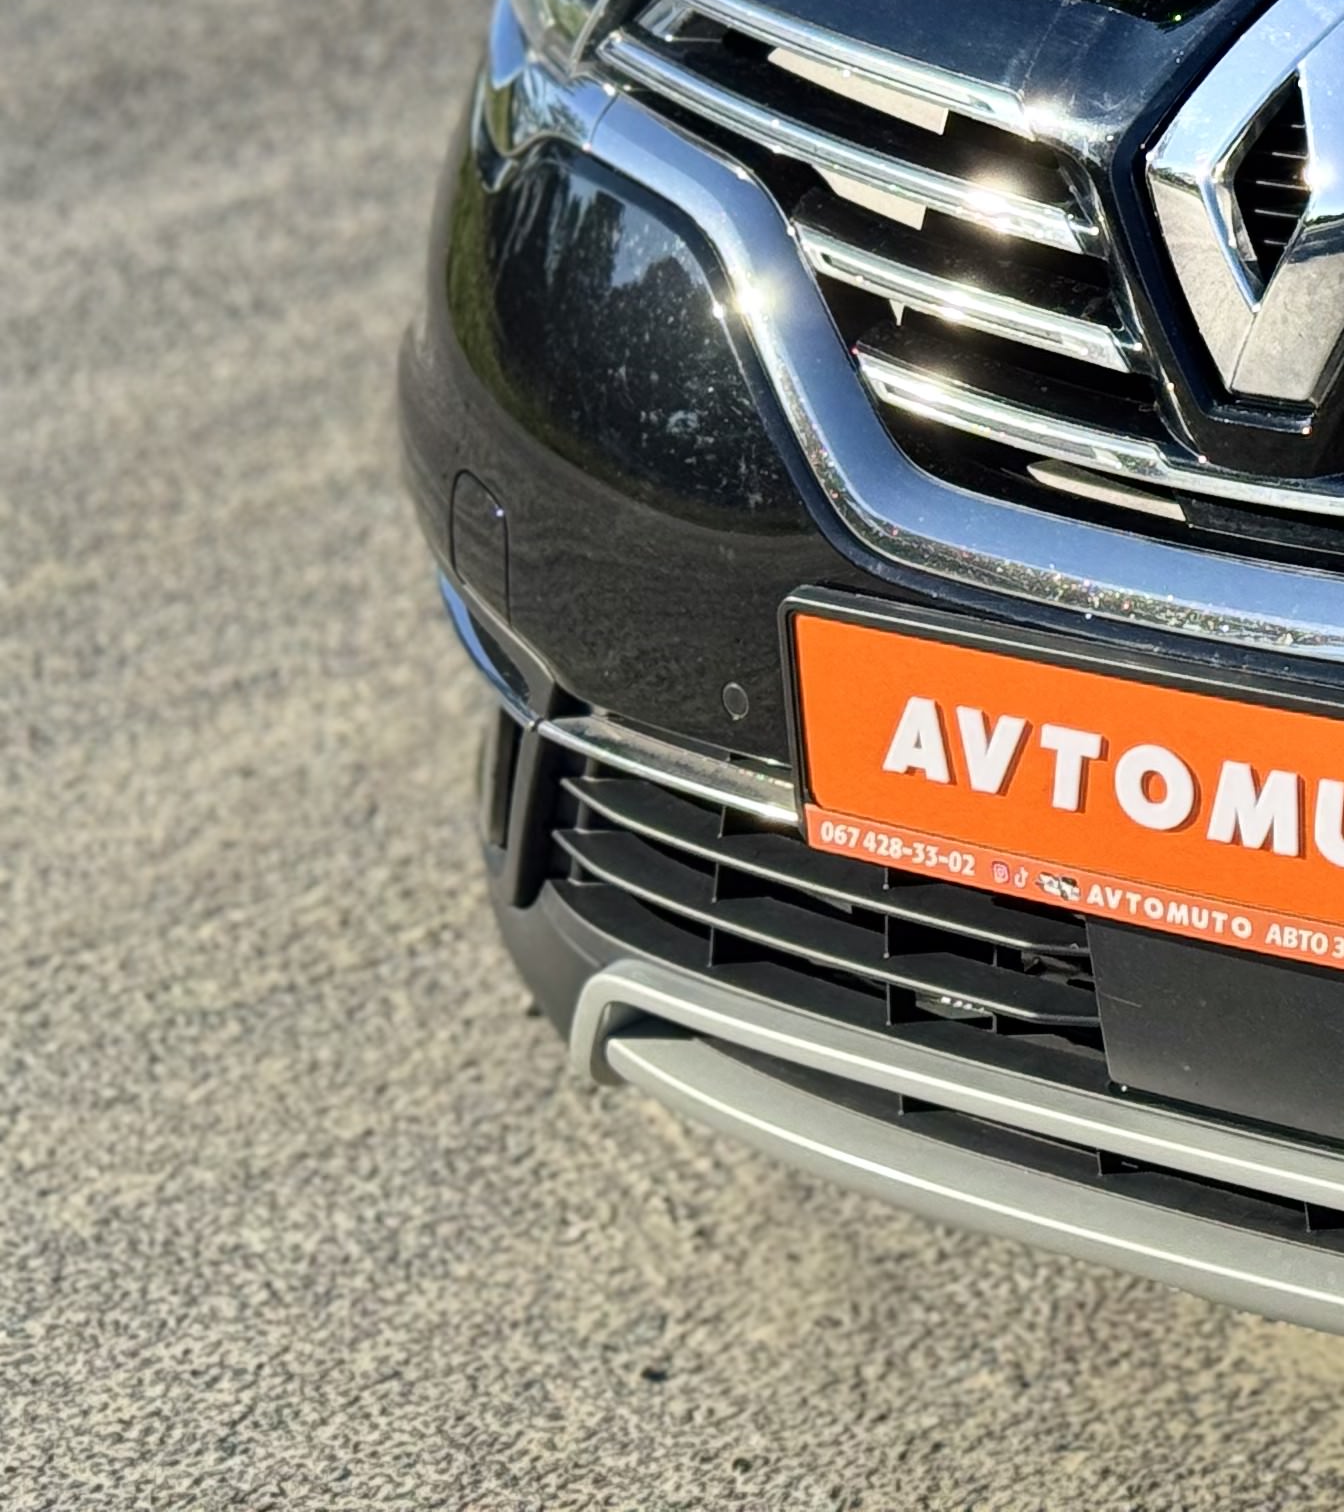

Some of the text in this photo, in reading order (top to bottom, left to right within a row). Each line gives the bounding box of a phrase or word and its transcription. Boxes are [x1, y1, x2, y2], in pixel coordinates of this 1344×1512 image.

[819, 820, 976, 876] 067 428-33-02
[1086, 882, 1253, 940] AVTOMUTO
[1264, 922, 1328, 955] АВТО
